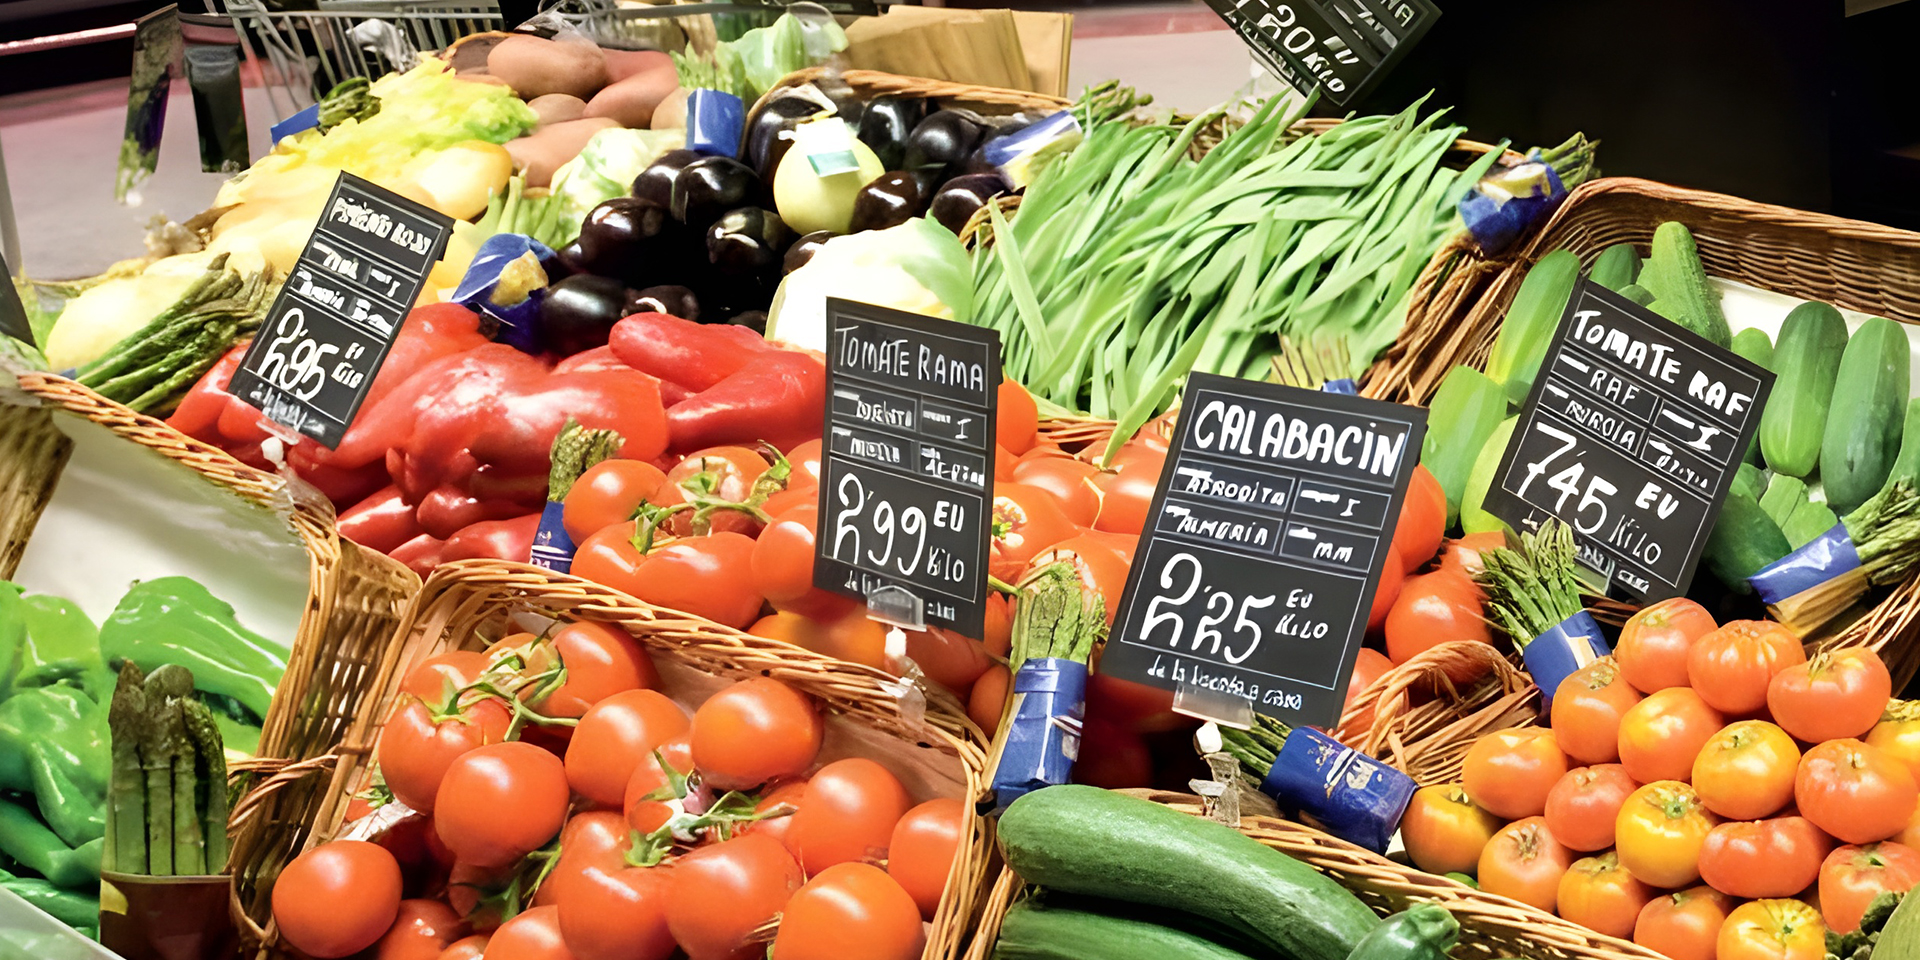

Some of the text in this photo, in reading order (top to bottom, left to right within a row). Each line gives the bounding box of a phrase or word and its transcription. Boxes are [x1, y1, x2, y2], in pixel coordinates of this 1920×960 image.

[835, 326, 984, 392] TOMATE RAMA
[1573, 310, 1753, 416] TOMATE RAF
[1589, 369, 1641, 406] RAF
[1515, 421, 1618, 536] 7'45
[1635, 481, 1680, 520] EU
[833, 472, 927, 576] 2'99
[933, 500, 965, 532] EU
[1139, 553, 1276, 664] 2'25
[1286, 588, 1313, 609] EU
